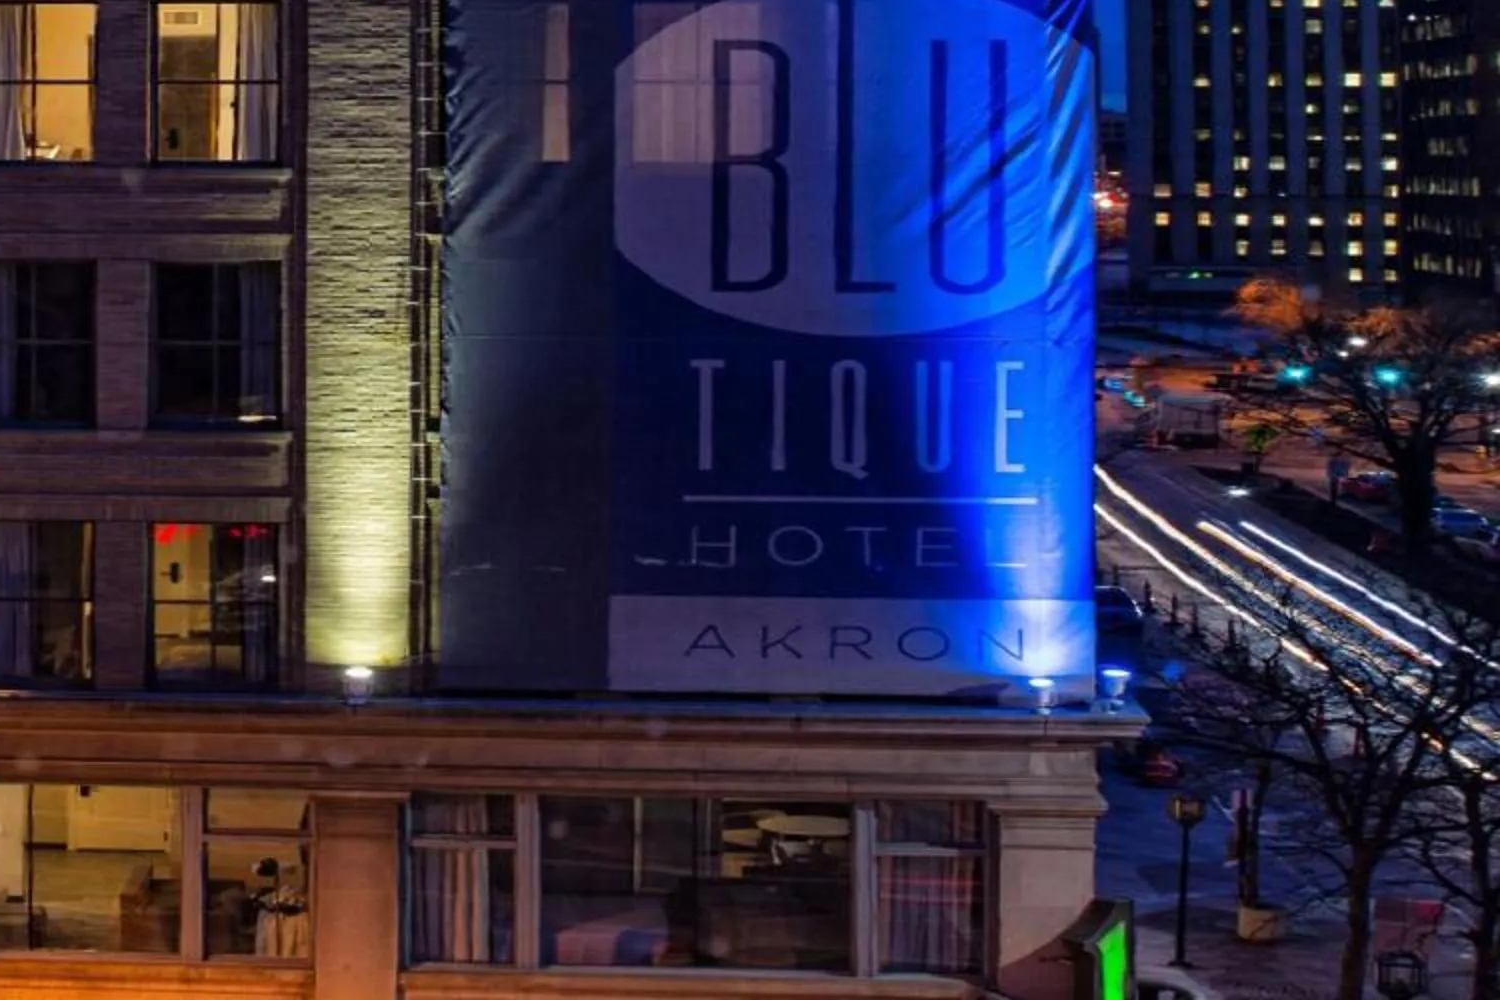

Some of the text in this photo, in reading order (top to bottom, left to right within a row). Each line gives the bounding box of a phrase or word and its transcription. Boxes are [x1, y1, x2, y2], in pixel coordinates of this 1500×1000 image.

[690, 359, 1025, 479] TIQUE
[692, 525, 1027, 567] HOTEL
[684, 624, 1023, 661] AKRON
